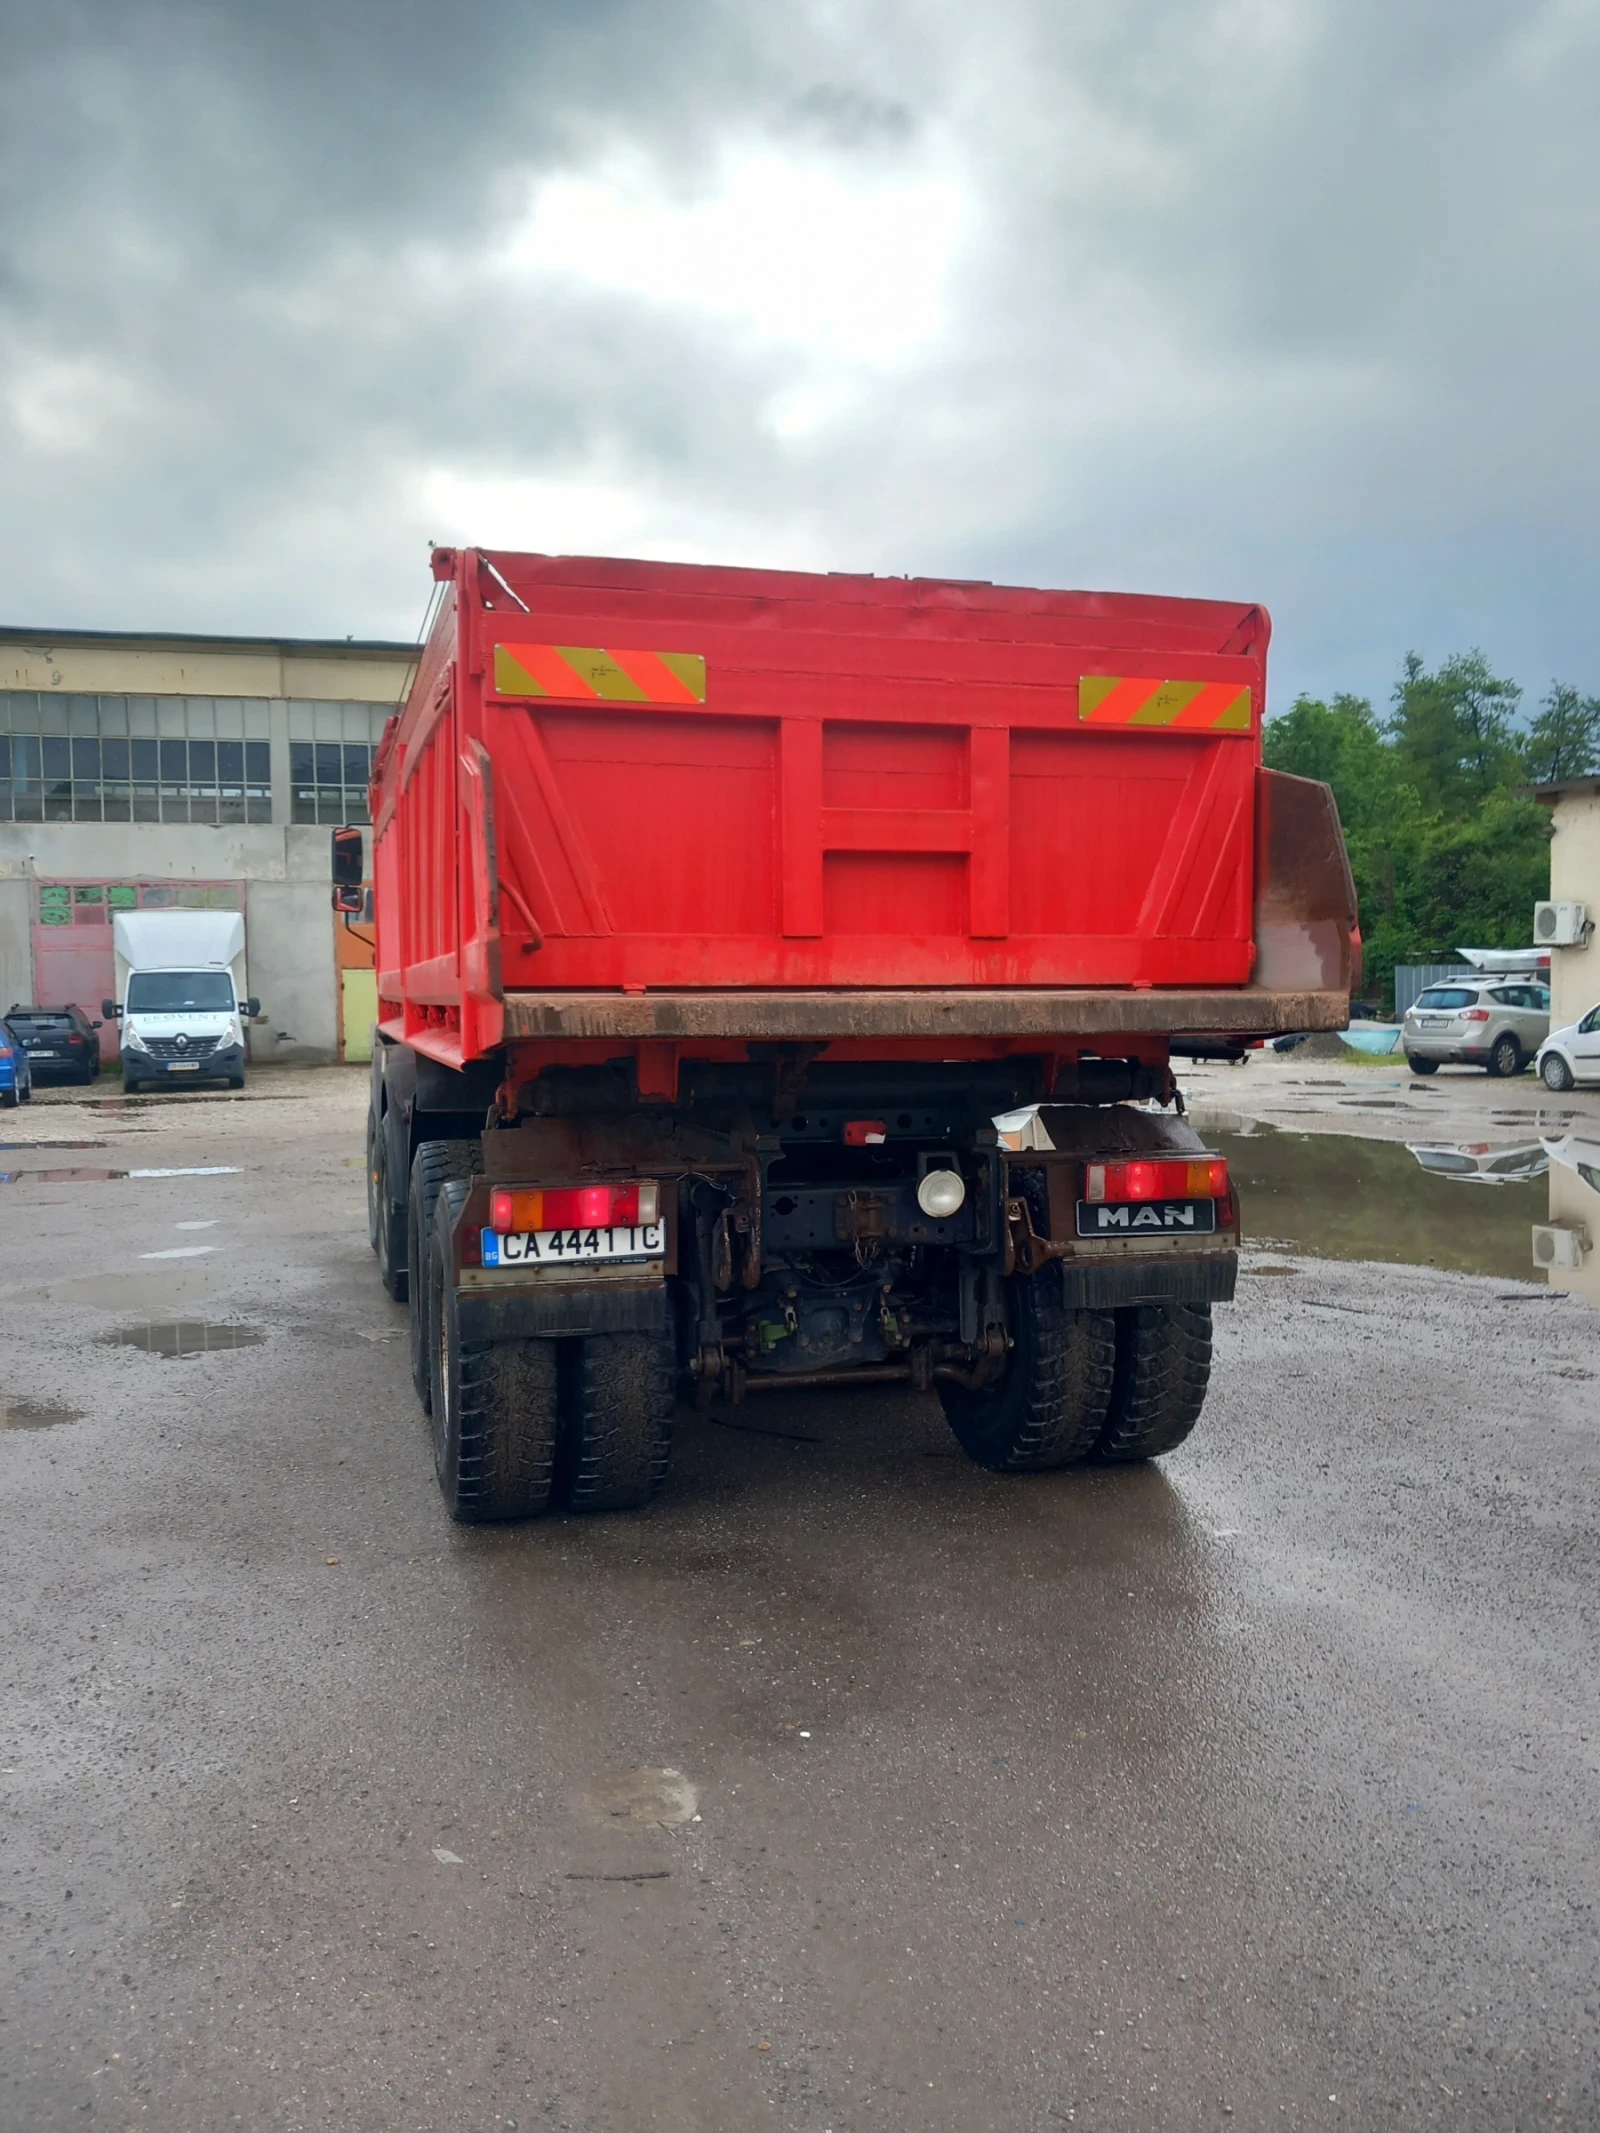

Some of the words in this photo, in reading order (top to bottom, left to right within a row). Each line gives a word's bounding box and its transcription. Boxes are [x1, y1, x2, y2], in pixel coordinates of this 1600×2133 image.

[1098, 1205, 1194, 1227] MAN
[503, 1230, 541, 1260] CA
[548, 1227, 613, 1256] 4441
[623, 1225, 660, 1251] TC
[485, 1252, 498, 1261] BG
